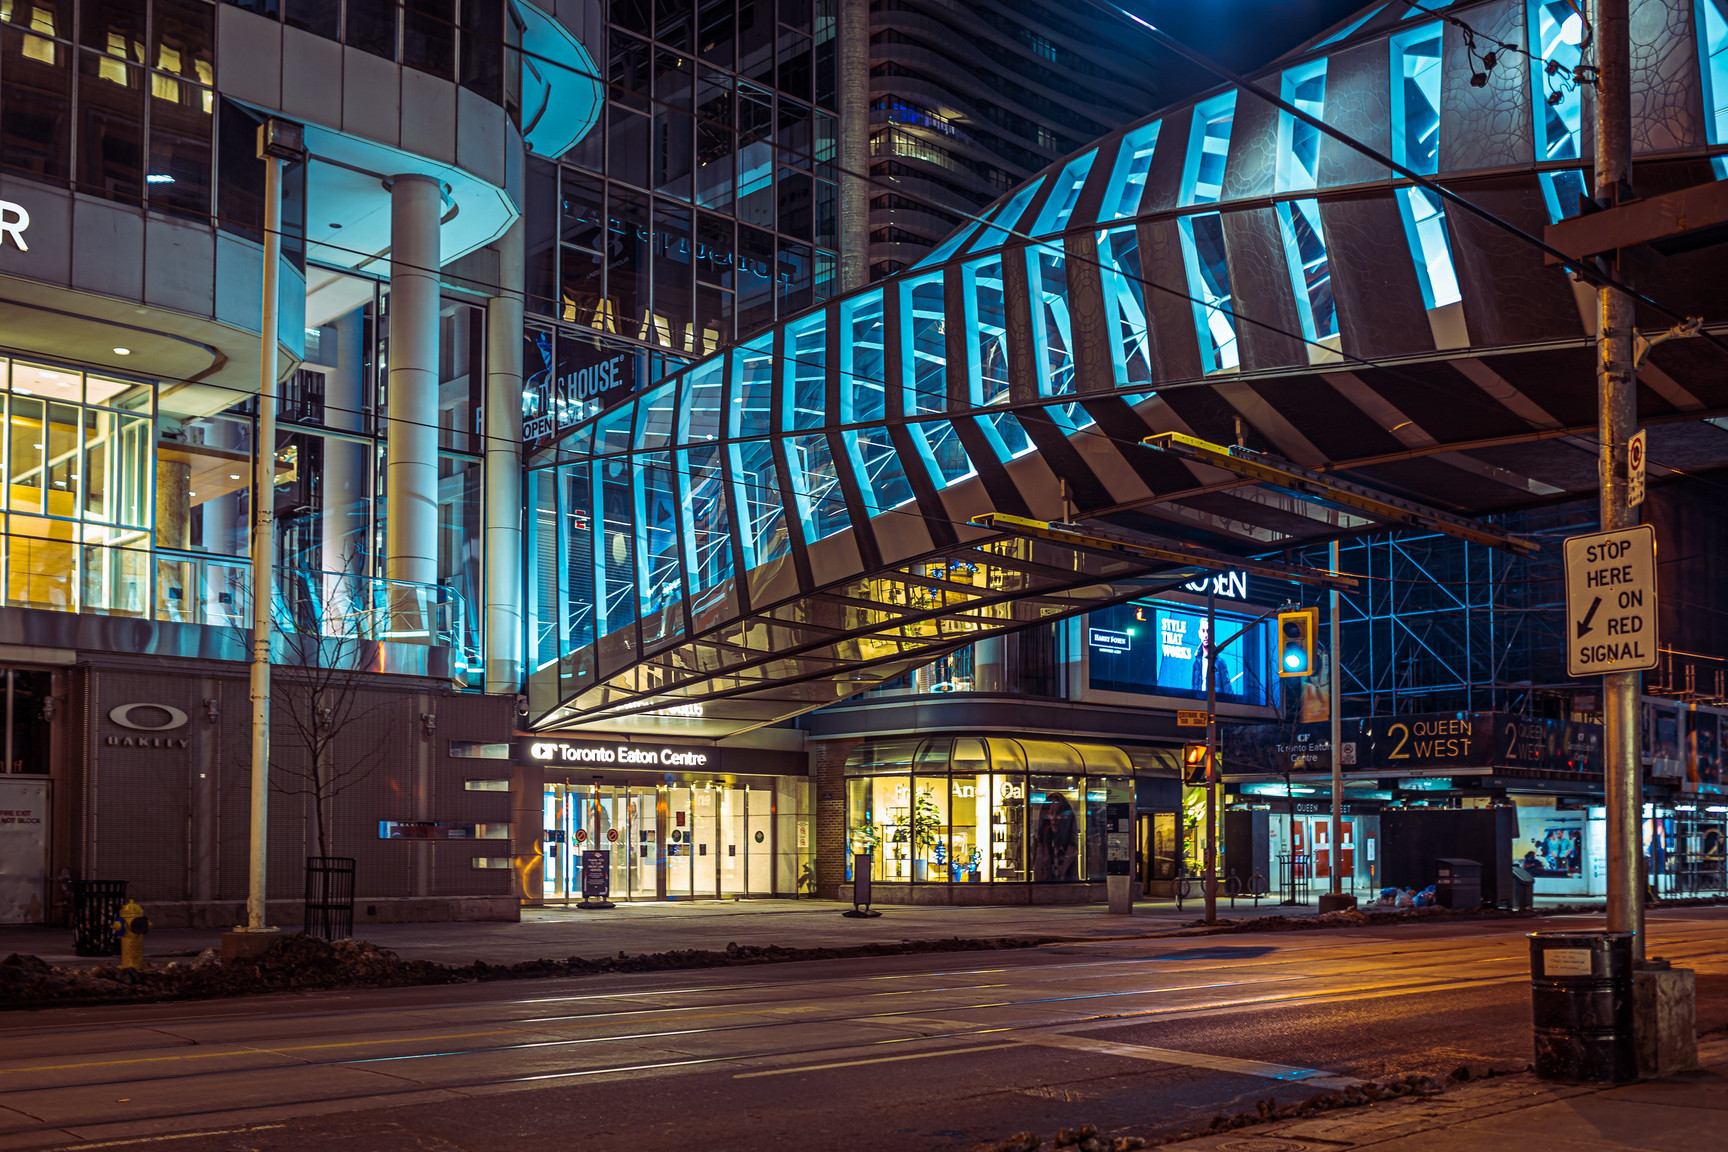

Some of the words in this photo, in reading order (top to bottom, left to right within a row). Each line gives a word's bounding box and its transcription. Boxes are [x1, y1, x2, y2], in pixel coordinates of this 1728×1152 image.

[523, 418, 552, 439] OPEN
[1586, 540, 1631, 563] STOP
[1587, 565, 1633, 588] HERE
[1618, 589, 1643, 609] ON
[1161, 618, 1186, 633] STYLE
[1607, 616, 1643, 636] RED
[1161, 631, 1183, 646] THAT
[1162, 644, 1191, 660] WORKS
[1580, 641, 1645, 664] SIGNAL
[1413, 719, 1472, 736] QUEEN
[108, 735, 188, 748] OAKLEY
[1387, 723, 1410, 760] 2
[1413, 738, 1472, 758] WEST
[1505, 722, 1517, 759] 2
[559, 744, 615, 762] Toronto
[617, 747, 658, 765] Eaton
[660, 749, 707, 766] Centre
[1296, 803, 1318, 813] QUEEN
